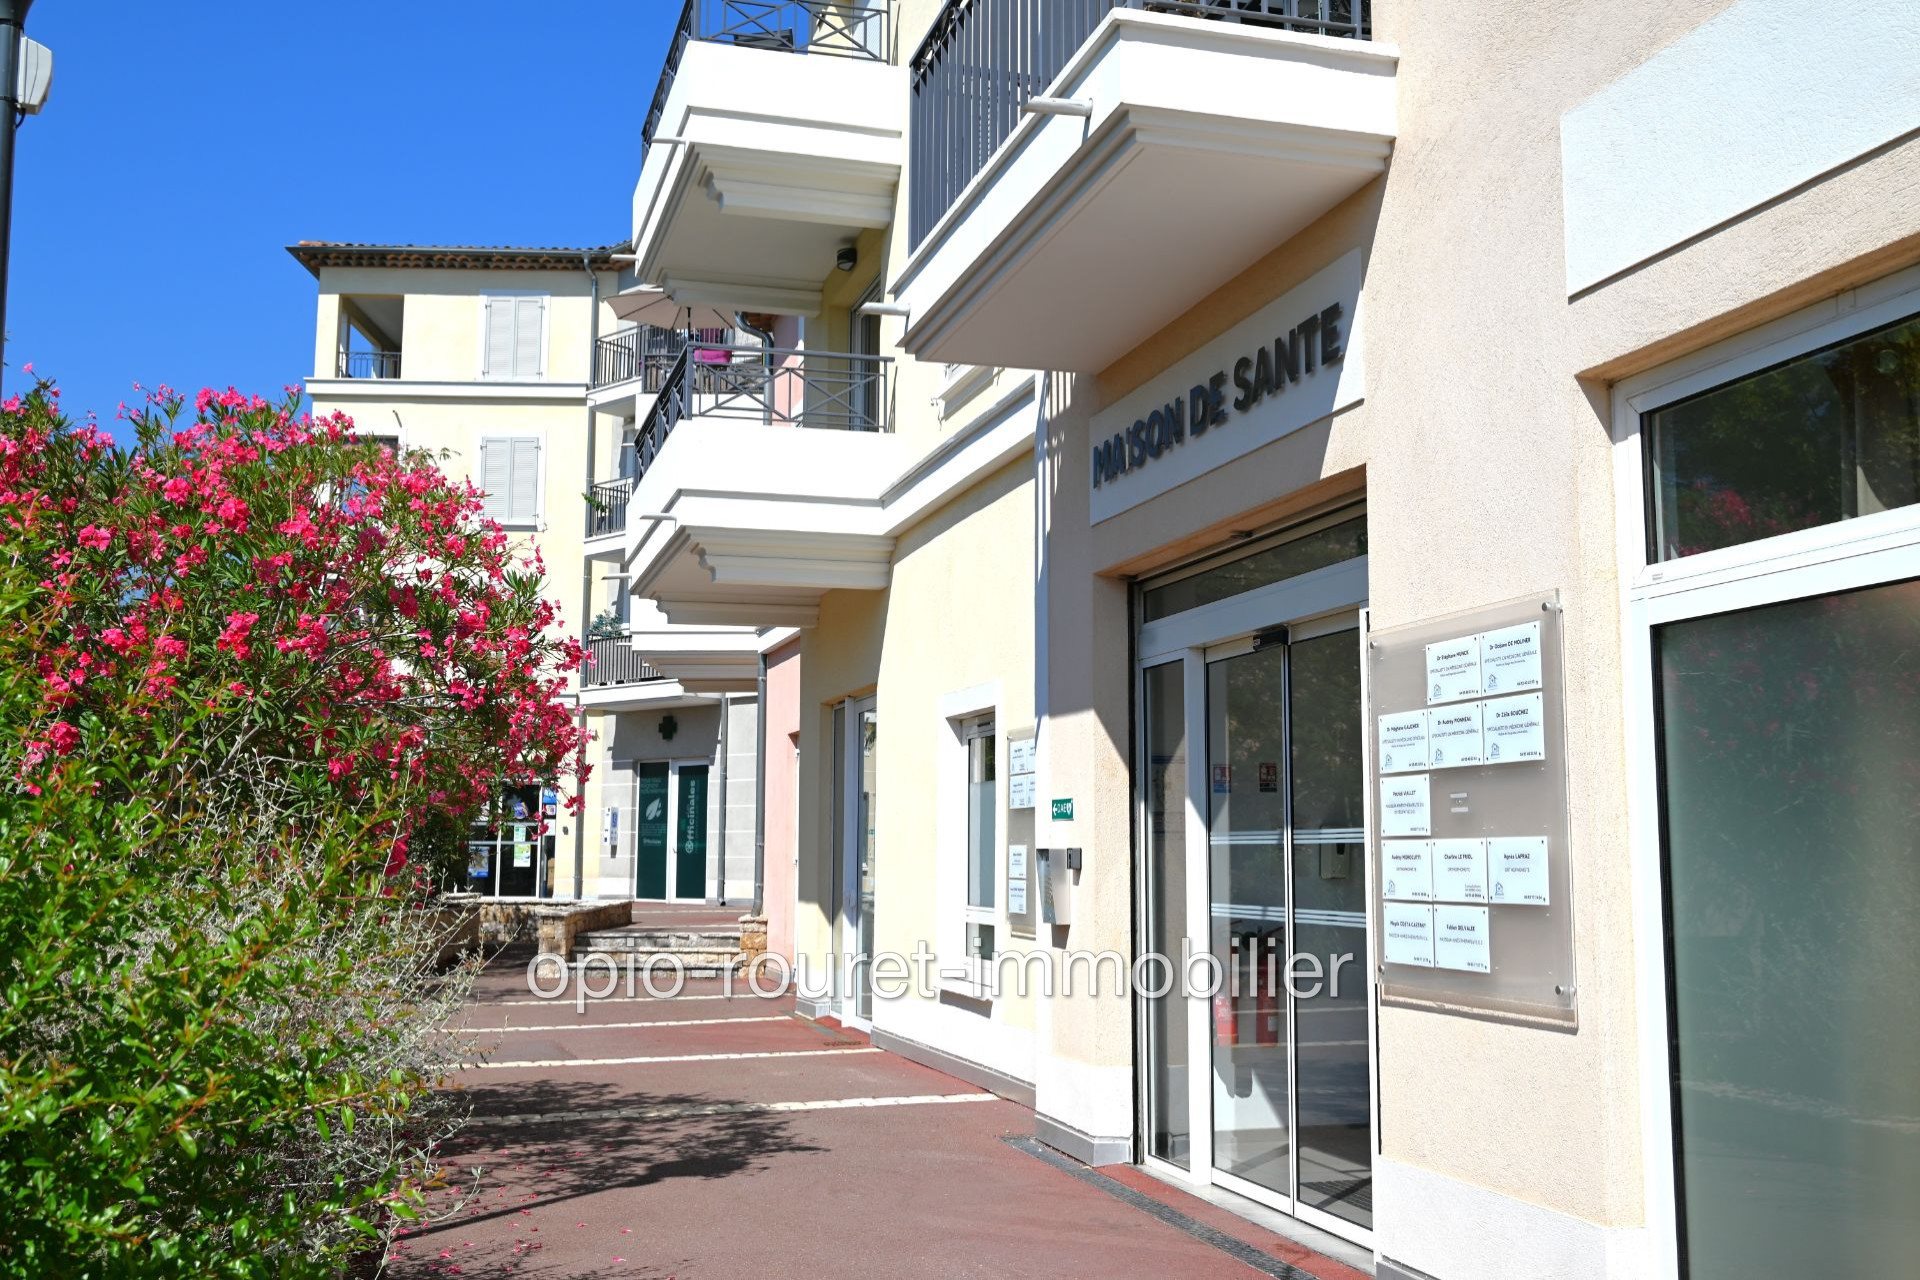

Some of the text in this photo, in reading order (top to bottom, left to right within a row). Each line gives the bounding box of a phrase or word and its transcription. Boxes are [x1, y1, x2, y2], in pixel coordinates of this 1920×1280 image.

[1093, 301, 1342, 489] MAISON DE SANTE
